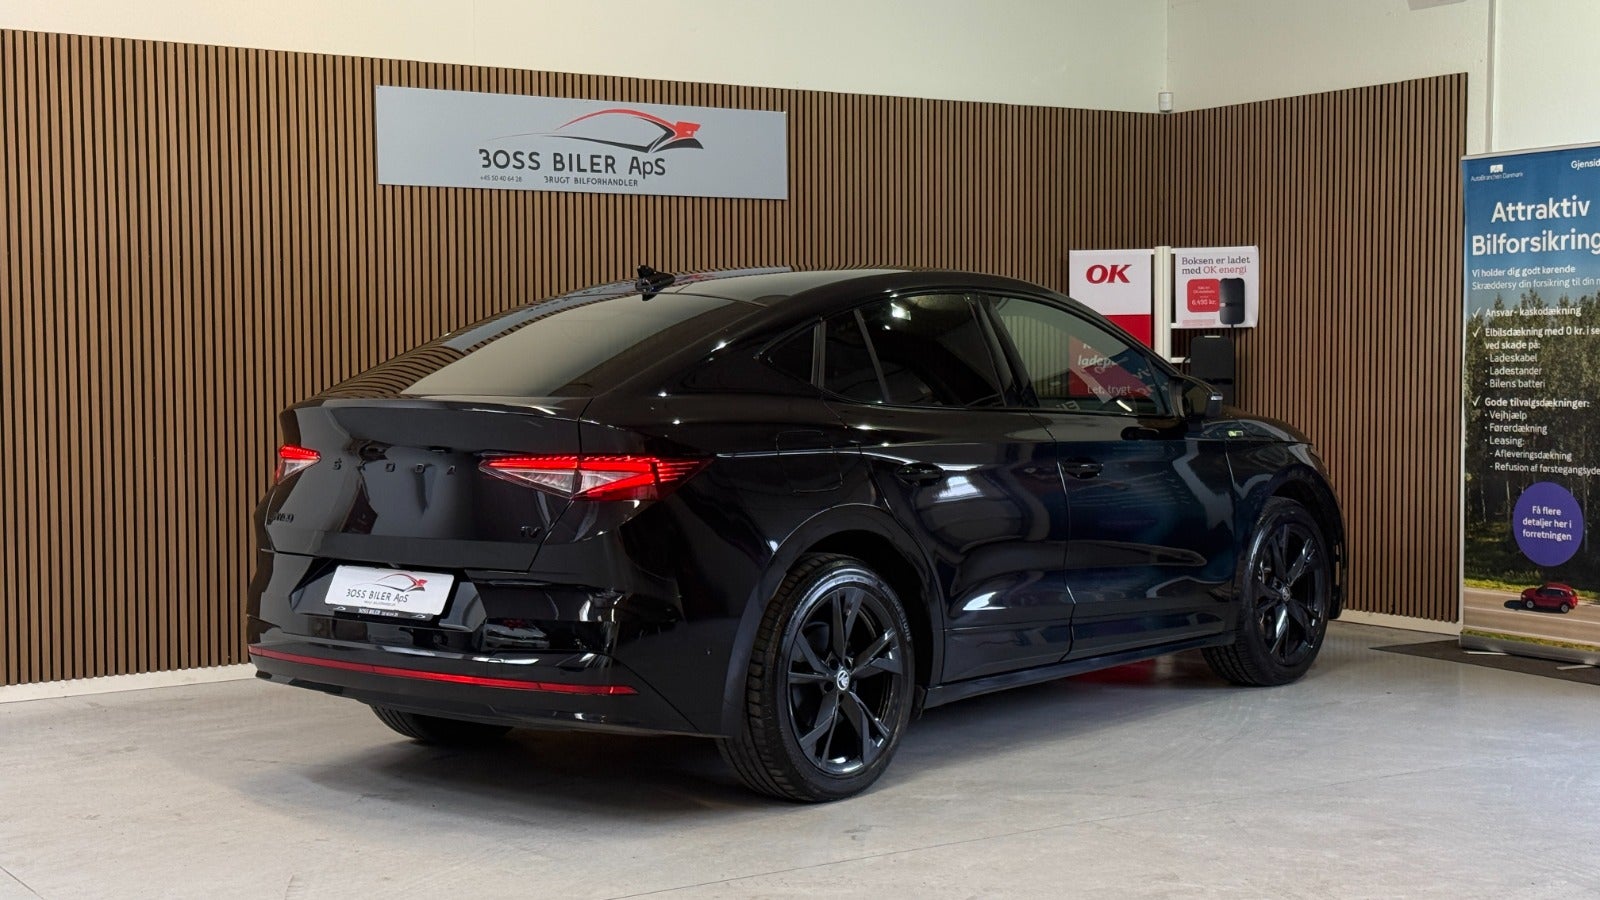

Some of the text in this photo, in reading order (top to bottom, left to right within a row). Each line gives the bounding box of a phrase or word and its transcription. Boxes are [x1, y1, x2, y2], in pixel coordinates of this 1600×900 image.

[553, 152, 616, 174] BILER
[628, 156, 666, 179] ApS
[574, 177, 638, 187] BILFORHANDLER
[1491, 194, 1591, 223] Attraktiv
[1472, 227, 1600, 256] Bilforsikring
[1181, 255, 1251, 266] Boksen er ladet
[1086, 264, 1132, 284] OK
[1181, 265, 1247, 276] med OK energi
[1472, 264, 1576, 278] Vi holder dig godt kørende
[1472, 280, 1517, 290] Skræddersy
[1518, 279, 1532, 288] din
[1533, 278, 1570, 289] forsikring
[1571, 277, 1581, 286] til
[1582, 276, 1595, 286] din
[1519, 306, 1582, 318] kaskodækning
[1485, 327, 1543, 338] Elbilsdækning
[1544, 327, 1564, 336] med
[1566, 326, 1572, 336] 0
[1574, 326, 1585, 336] kr.
[1485, 339, 1541, 351] ved skade på:
[1489, 352, 1538, 363] Ladeskabel
[1489, 366, 1543, 376] Ladestander
[1107, 384, 1132, 397] trygt
[1489, 379, 1546, 389] Bilens batteri
[1484, 396, 1590, 410] Gode tilvalgsdækninger:
[1489, 409, 1528, 422] Vejhjælp
[1489, 422, 1548, 436] Førerdækning
[1494, 449, 1573, 463] Afleveringsdækning
[1494, 461, 1530, 473] Refusion
[1530, 463, 1539, 473] af
[1532, 504, 1562, 517] Få flere
[1522, 517, 1552, 529] detaljer
[1553, 518, 1568, 529] her
[1522, 529, 1572, 542] forretningen
[368, 590, 392, 601] BILER
